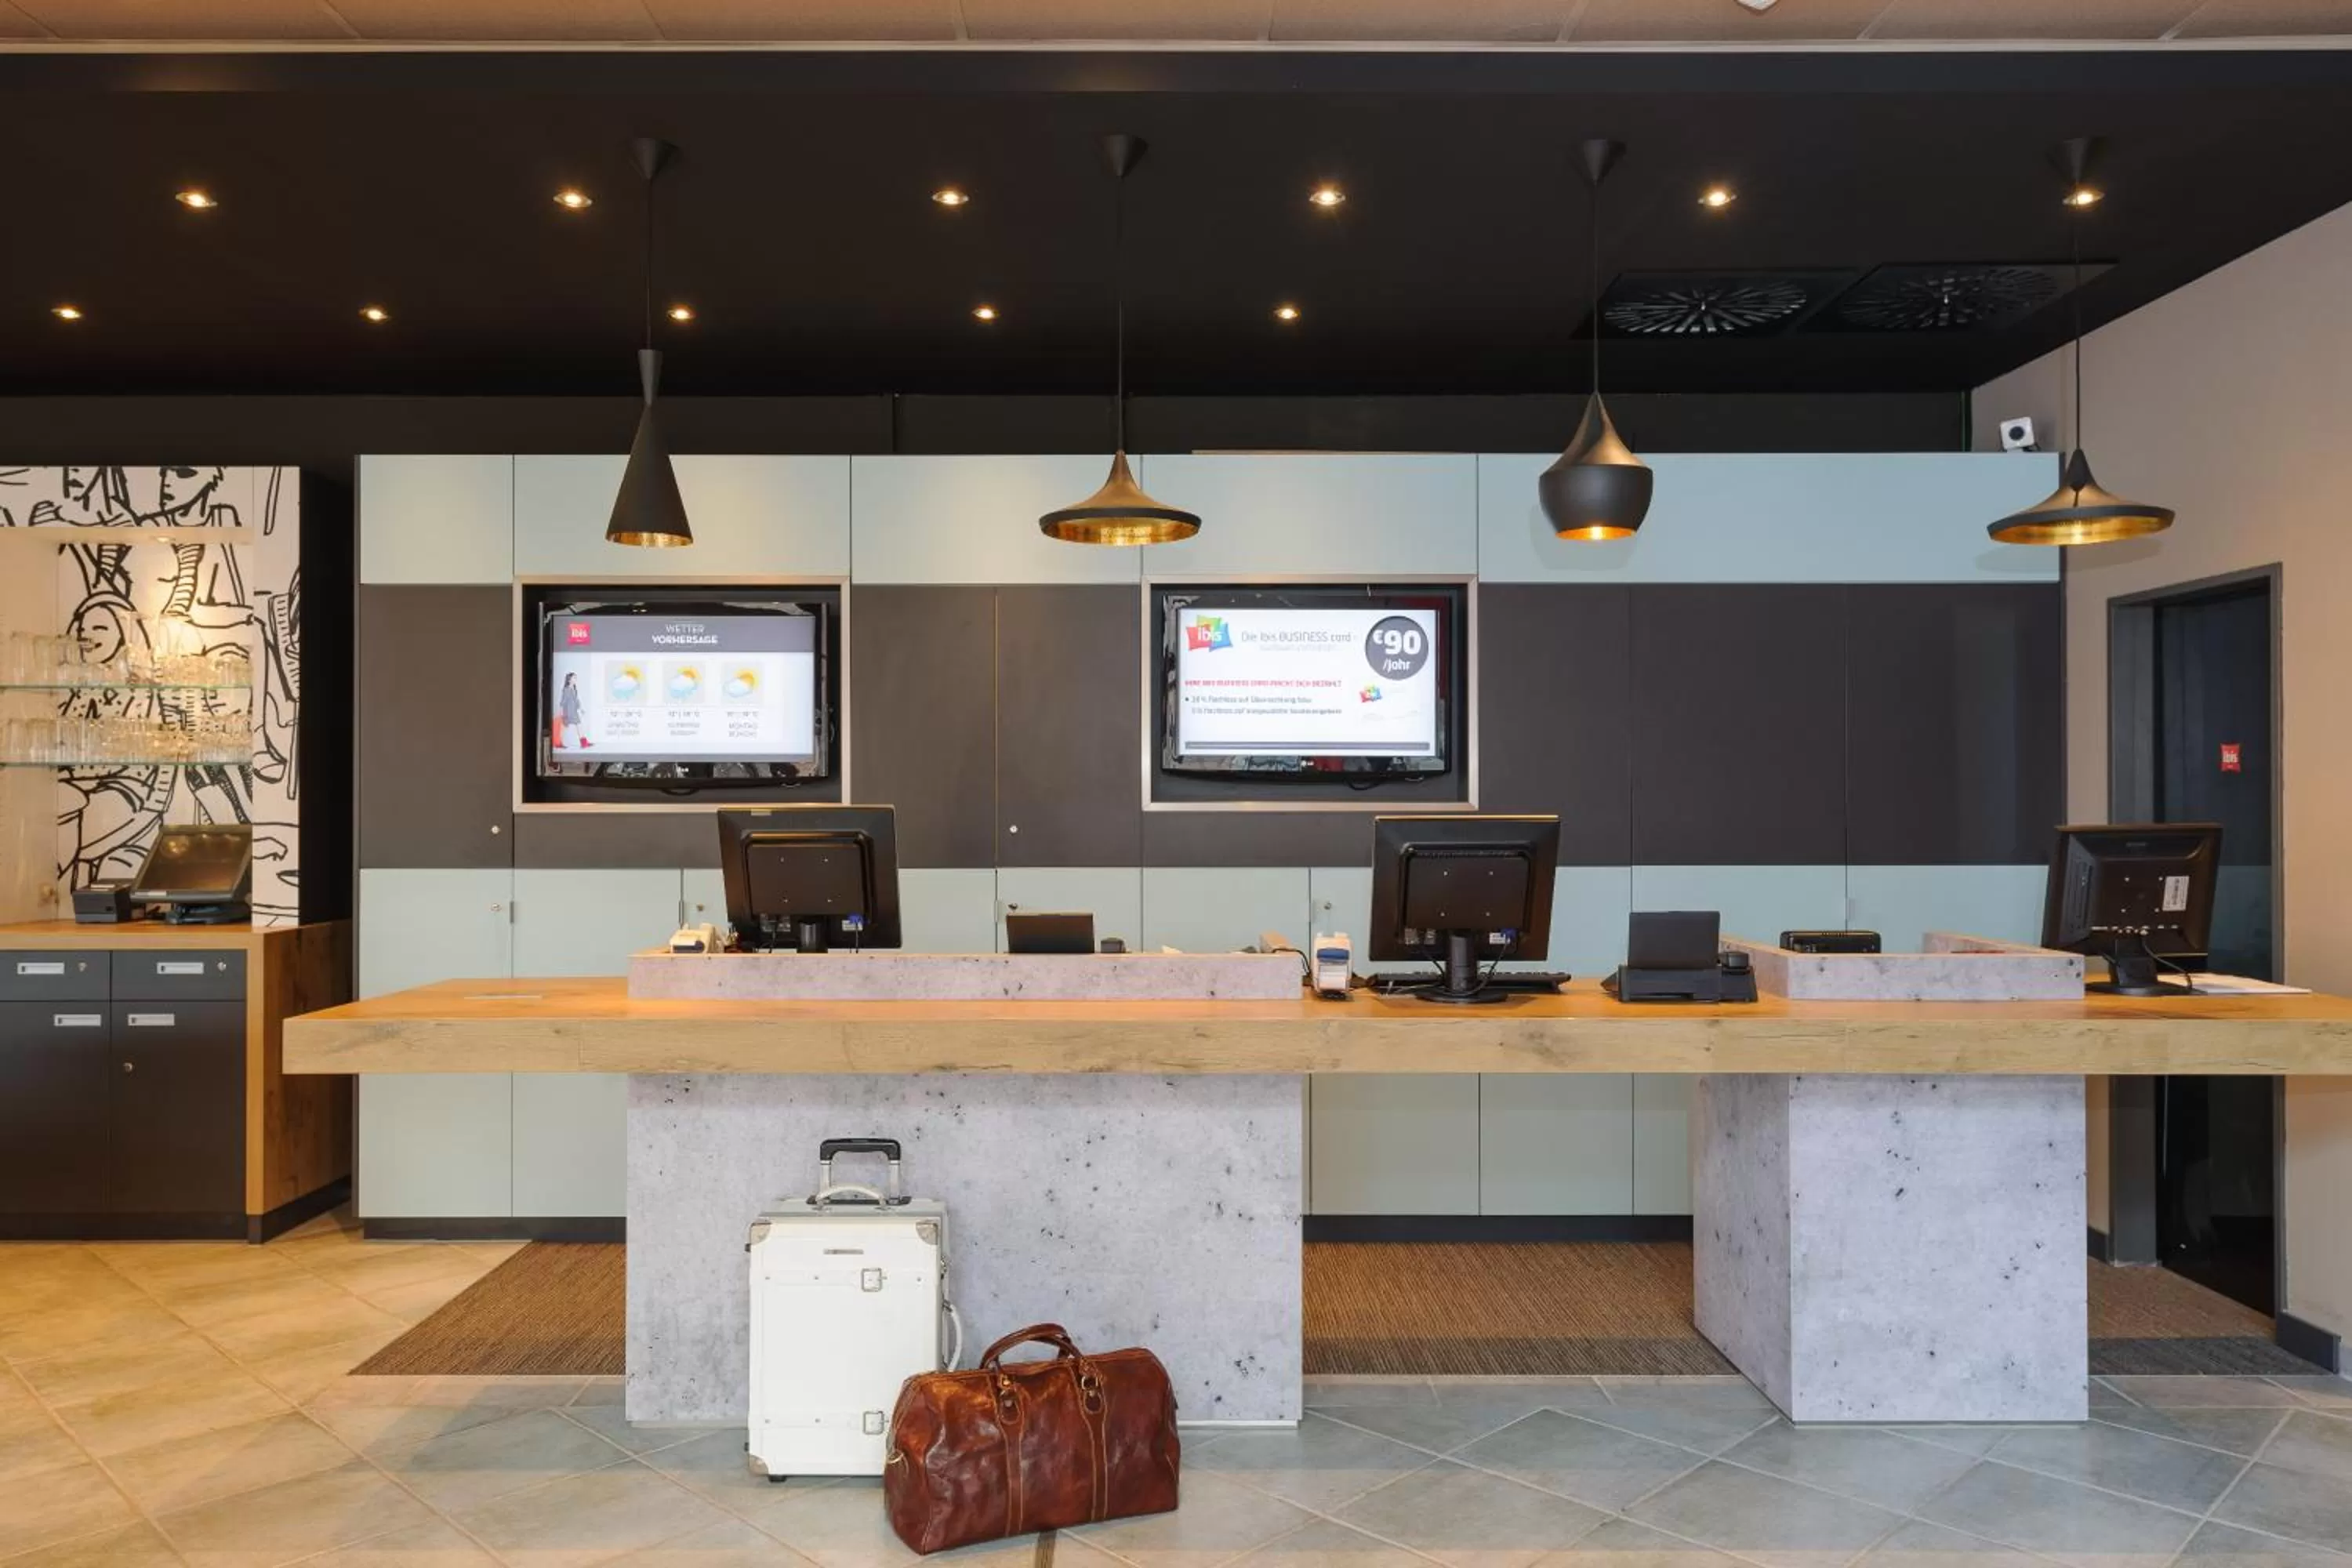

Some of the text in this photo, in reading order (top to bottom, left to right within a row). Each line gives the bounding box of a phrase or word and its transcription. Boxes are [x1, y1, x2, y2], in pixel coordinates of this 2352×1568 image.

[666, 624, 704, 633] WETTER
[1197, 626, 1223, 641] ibis
[652, 635, 718, 644] VORHERSAGE
[1330, 631, 1351, 642] card
[1373, 630, 1421, 655] €90
